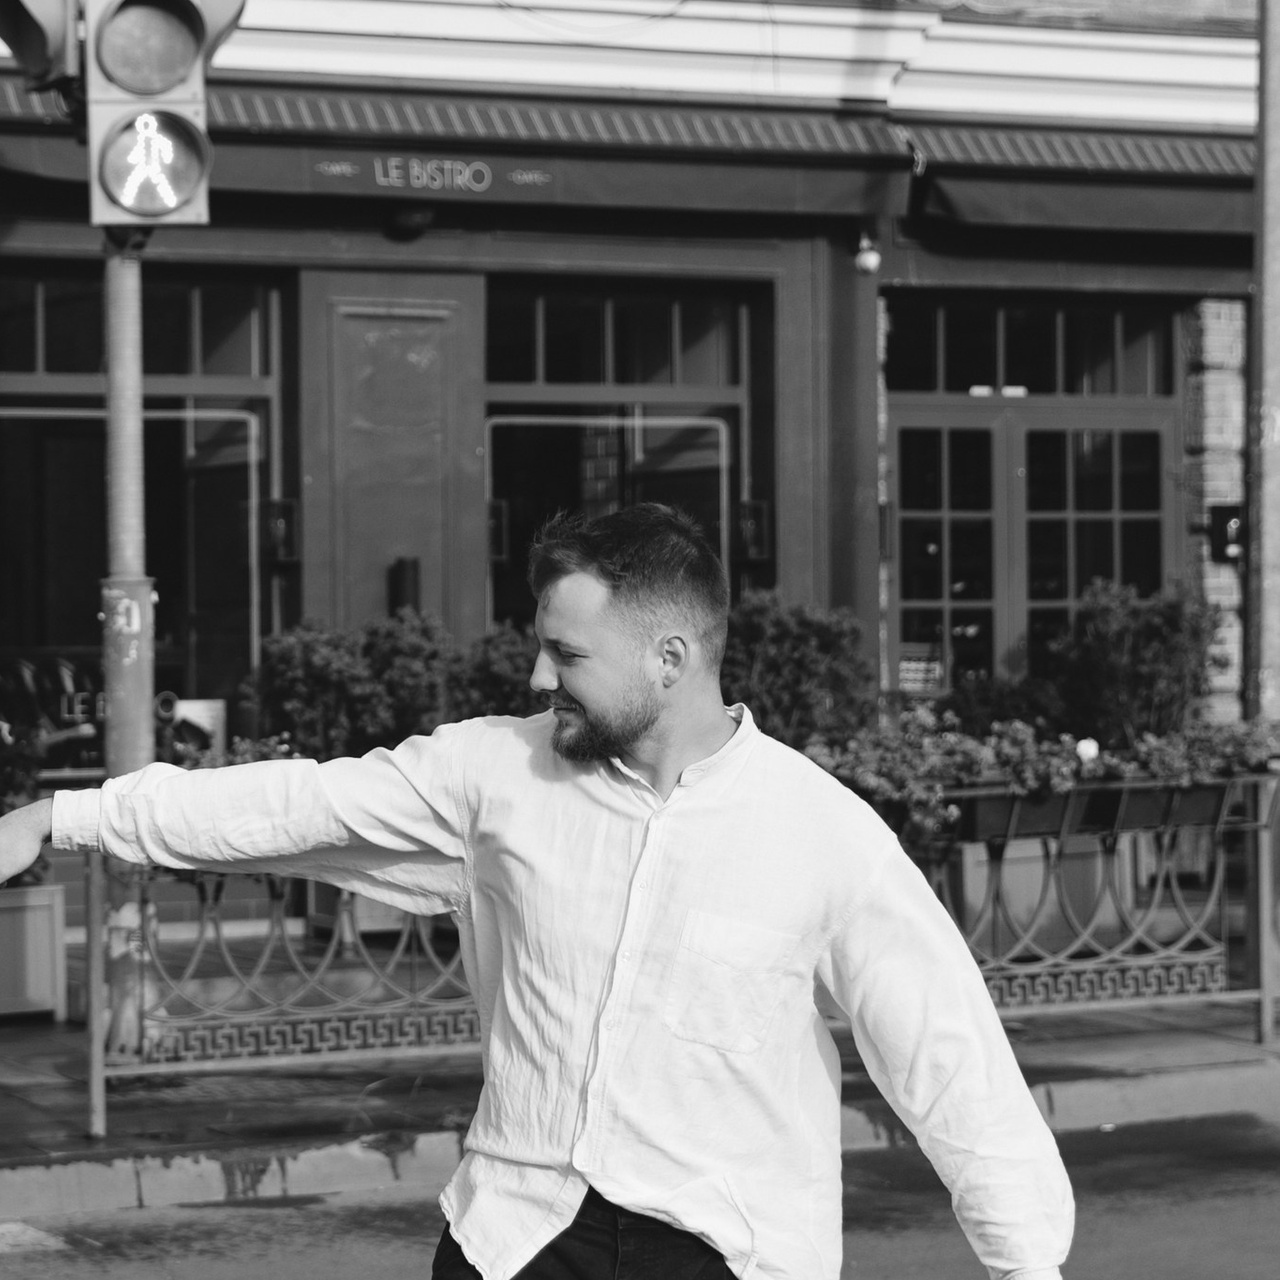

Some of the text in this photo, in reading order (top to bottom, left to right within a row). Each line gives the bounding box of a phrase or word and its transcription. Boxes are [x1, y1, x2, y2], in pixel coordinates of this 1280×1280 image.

[373, 157, 405, 187] LE
[408, 158, 493, 192] BISTRO
[60, 692, 90, 721] LE
